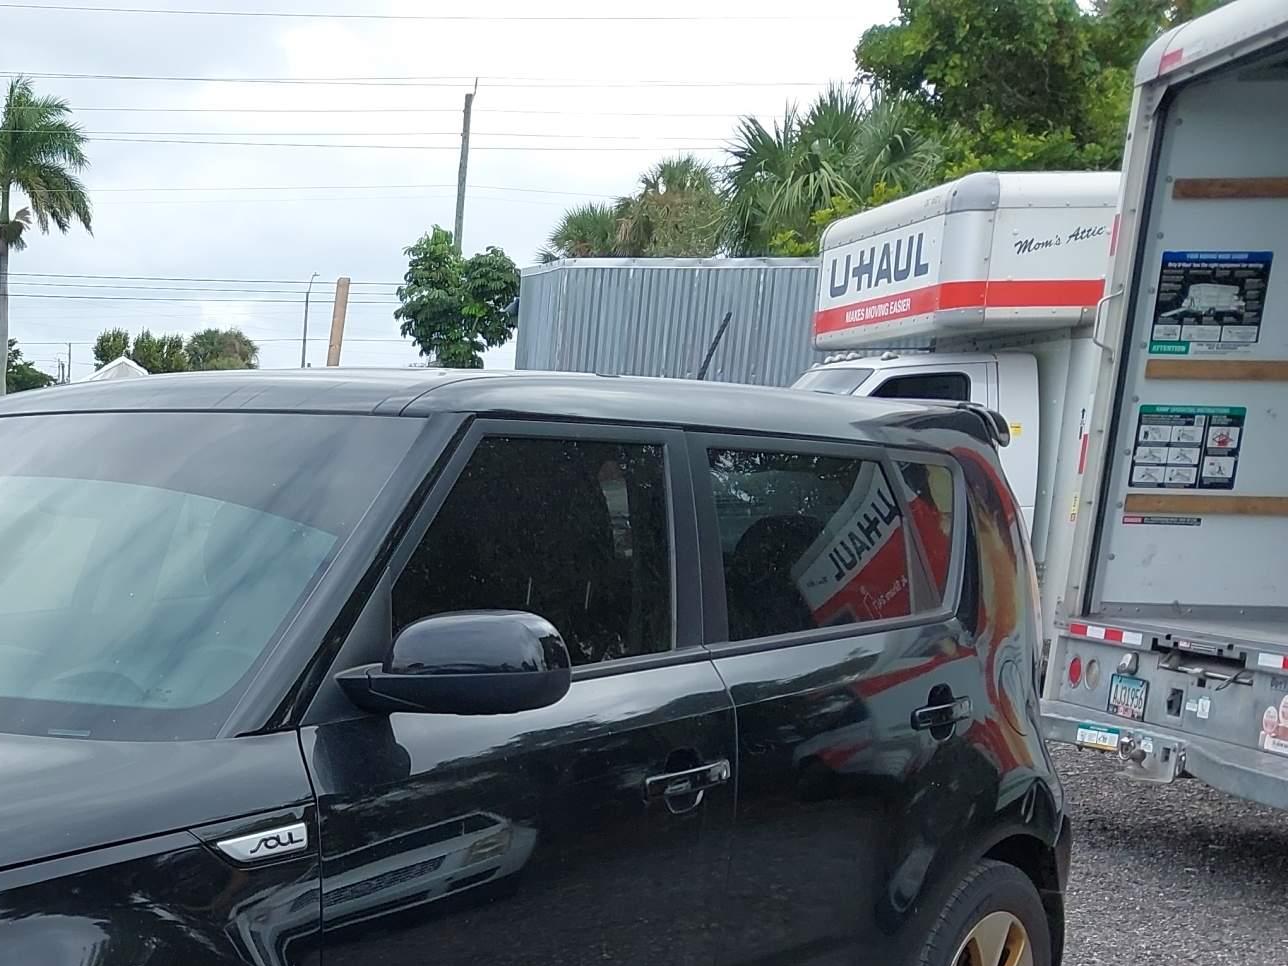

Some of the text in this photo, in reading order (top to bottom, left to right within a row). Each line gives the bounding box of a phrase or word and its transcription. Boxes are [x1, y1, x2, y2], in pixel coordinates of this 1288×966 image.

[1014, 226, 1106, 255] Mom's Attic
[829, 232, 929, 298] U-HAUL
[845, 298, 911, 323] MAKES MOVING EASIER
